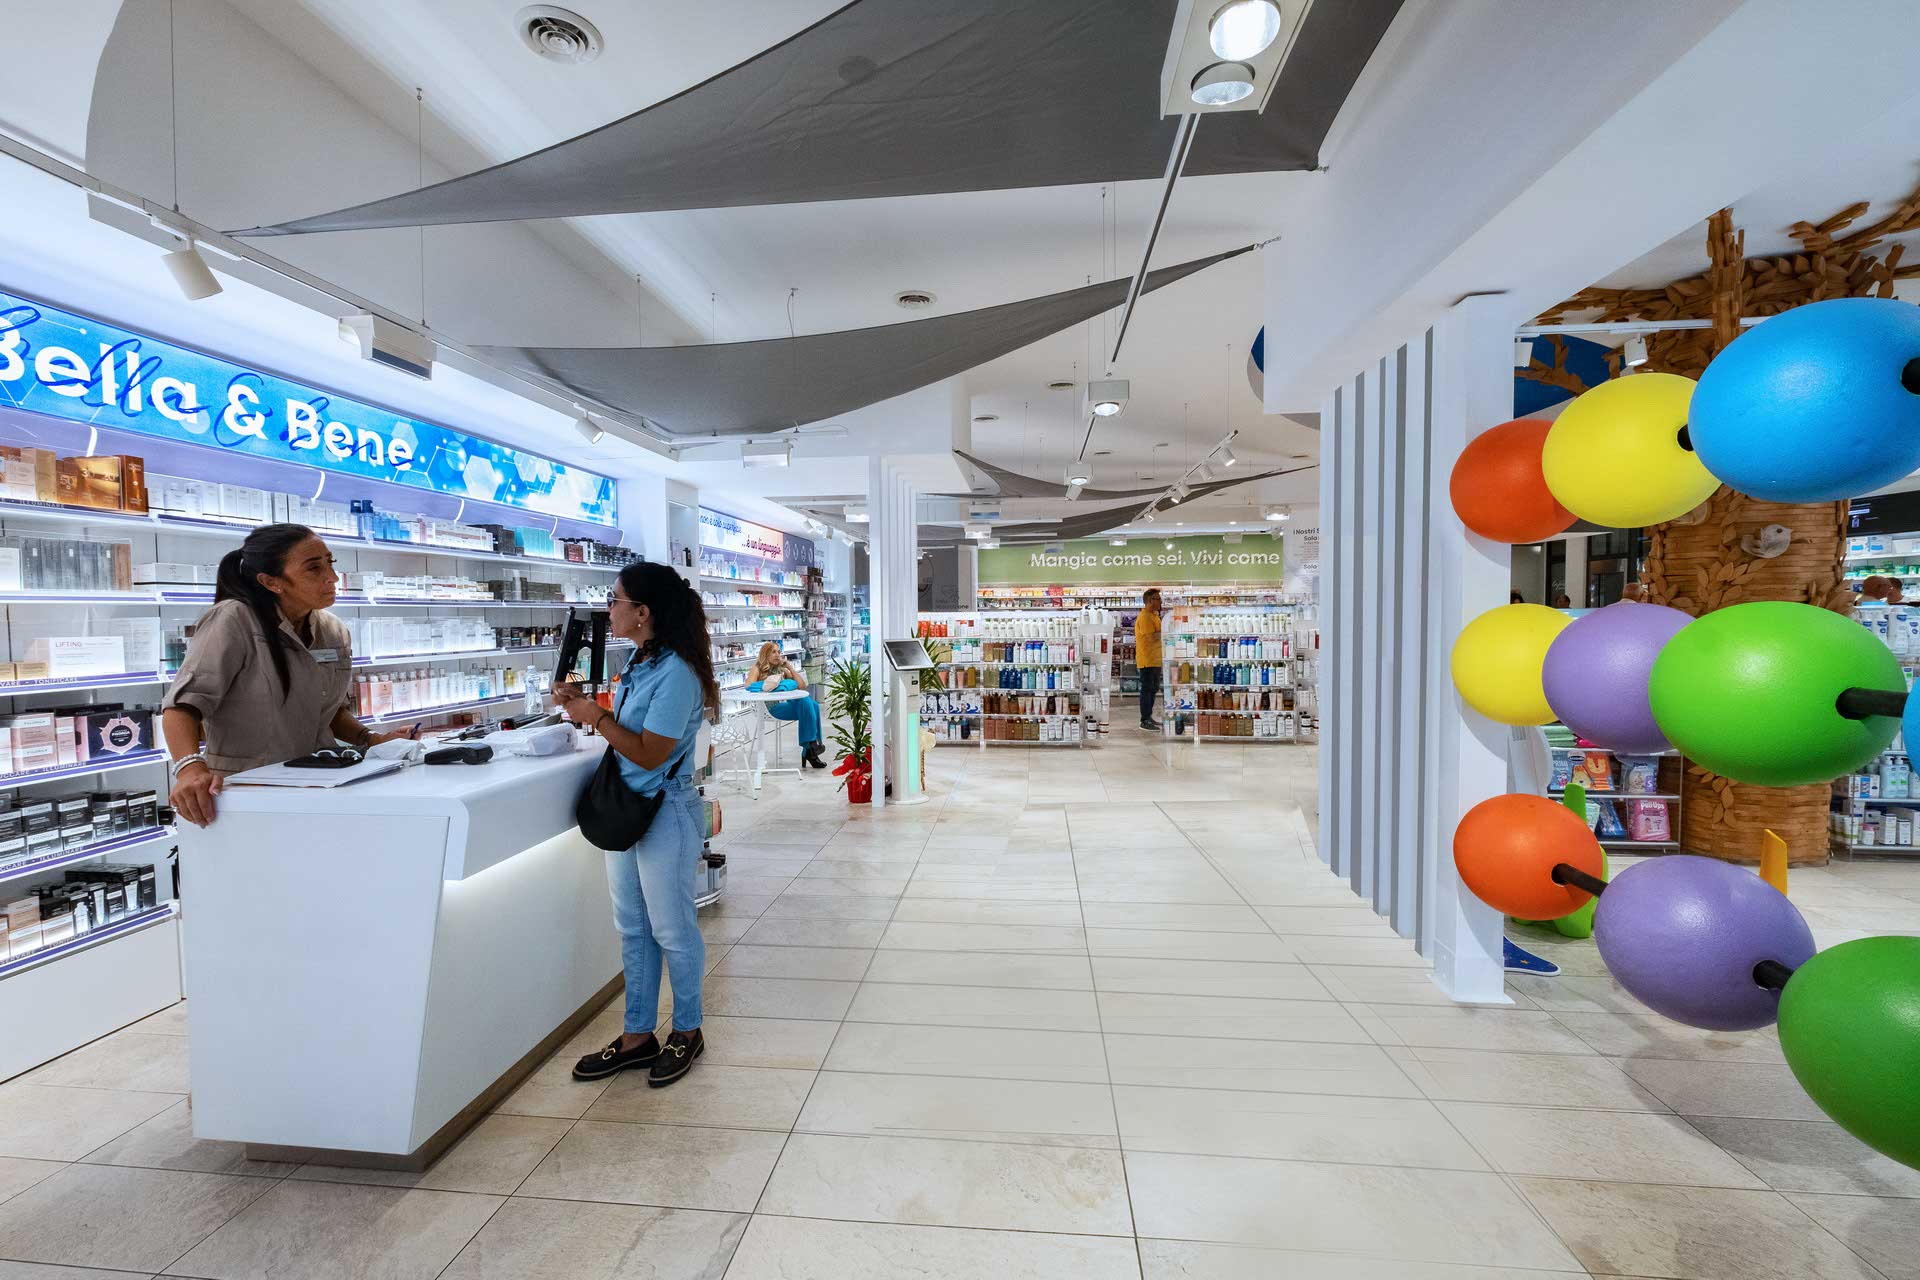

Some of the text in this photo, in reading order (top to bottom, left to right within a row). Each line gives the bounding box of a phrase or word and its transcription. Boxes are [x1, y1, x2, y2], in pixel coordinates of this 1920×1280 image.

[224, 384, 268, 440] &
[287, 399, 412, 470] Bene
[1030, 549, 1279, 570] Mangia come sei. Vivi come
[34, 677, 78, 685] TONIFICARE
[43, 761, 86, 772] ILLUMINARE
[40, 847, 83, 862] ILLUMINARE
